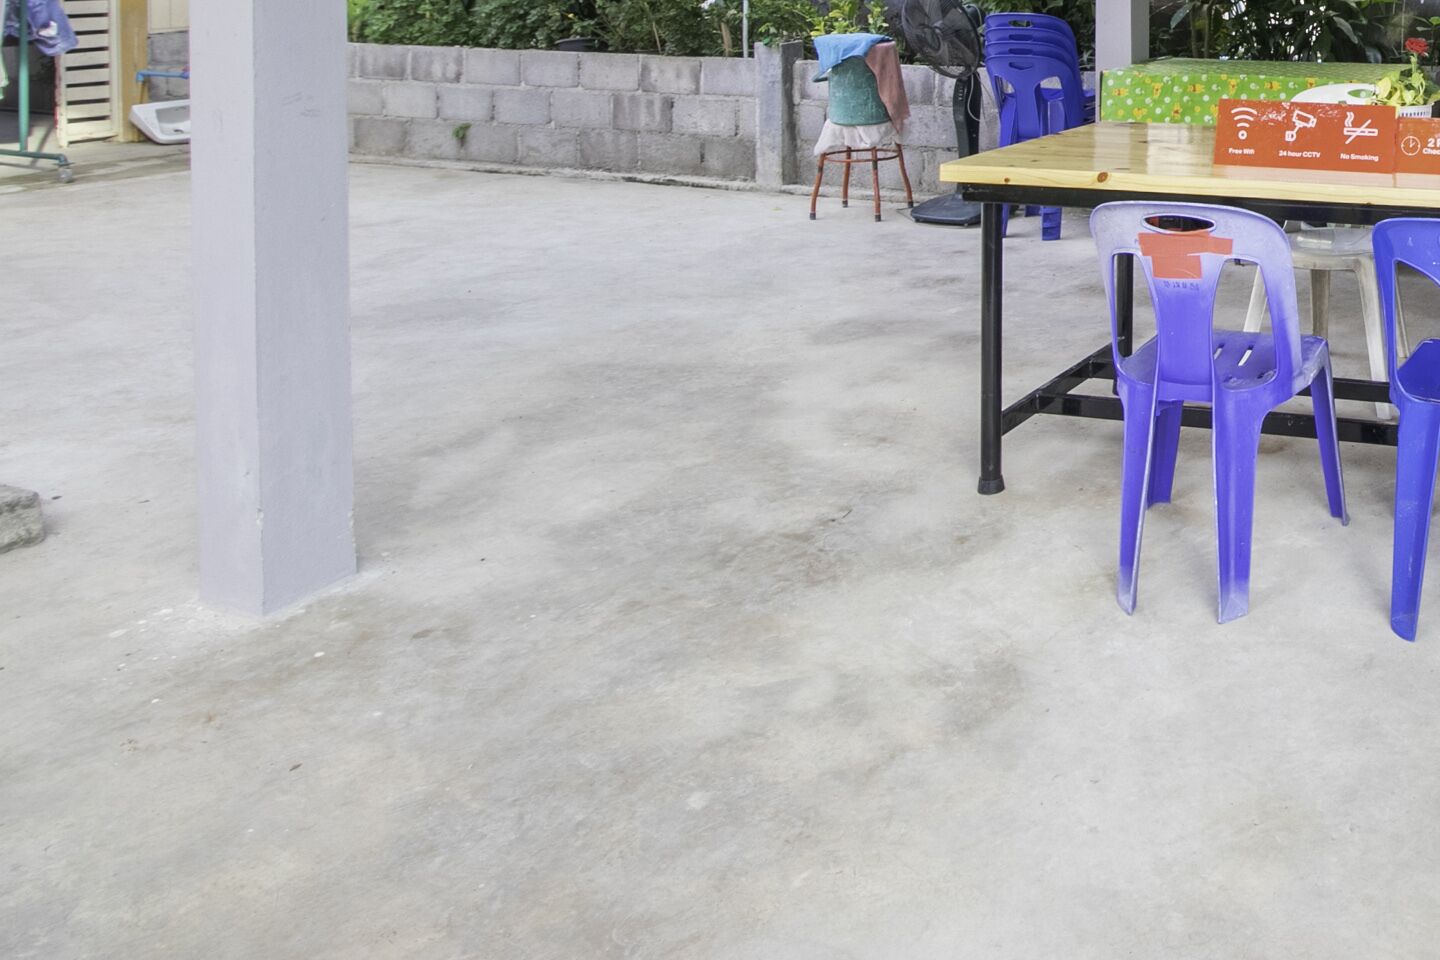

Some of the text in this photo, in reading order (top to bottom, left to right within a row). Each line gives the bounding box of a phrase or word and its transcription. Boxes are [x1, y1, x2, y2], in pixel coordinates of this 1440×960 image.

[1427, 138, 1435, 148] 2
[1287, 150, 1302, 158] hour
[1350, 153, 1379, 162] Smoking
